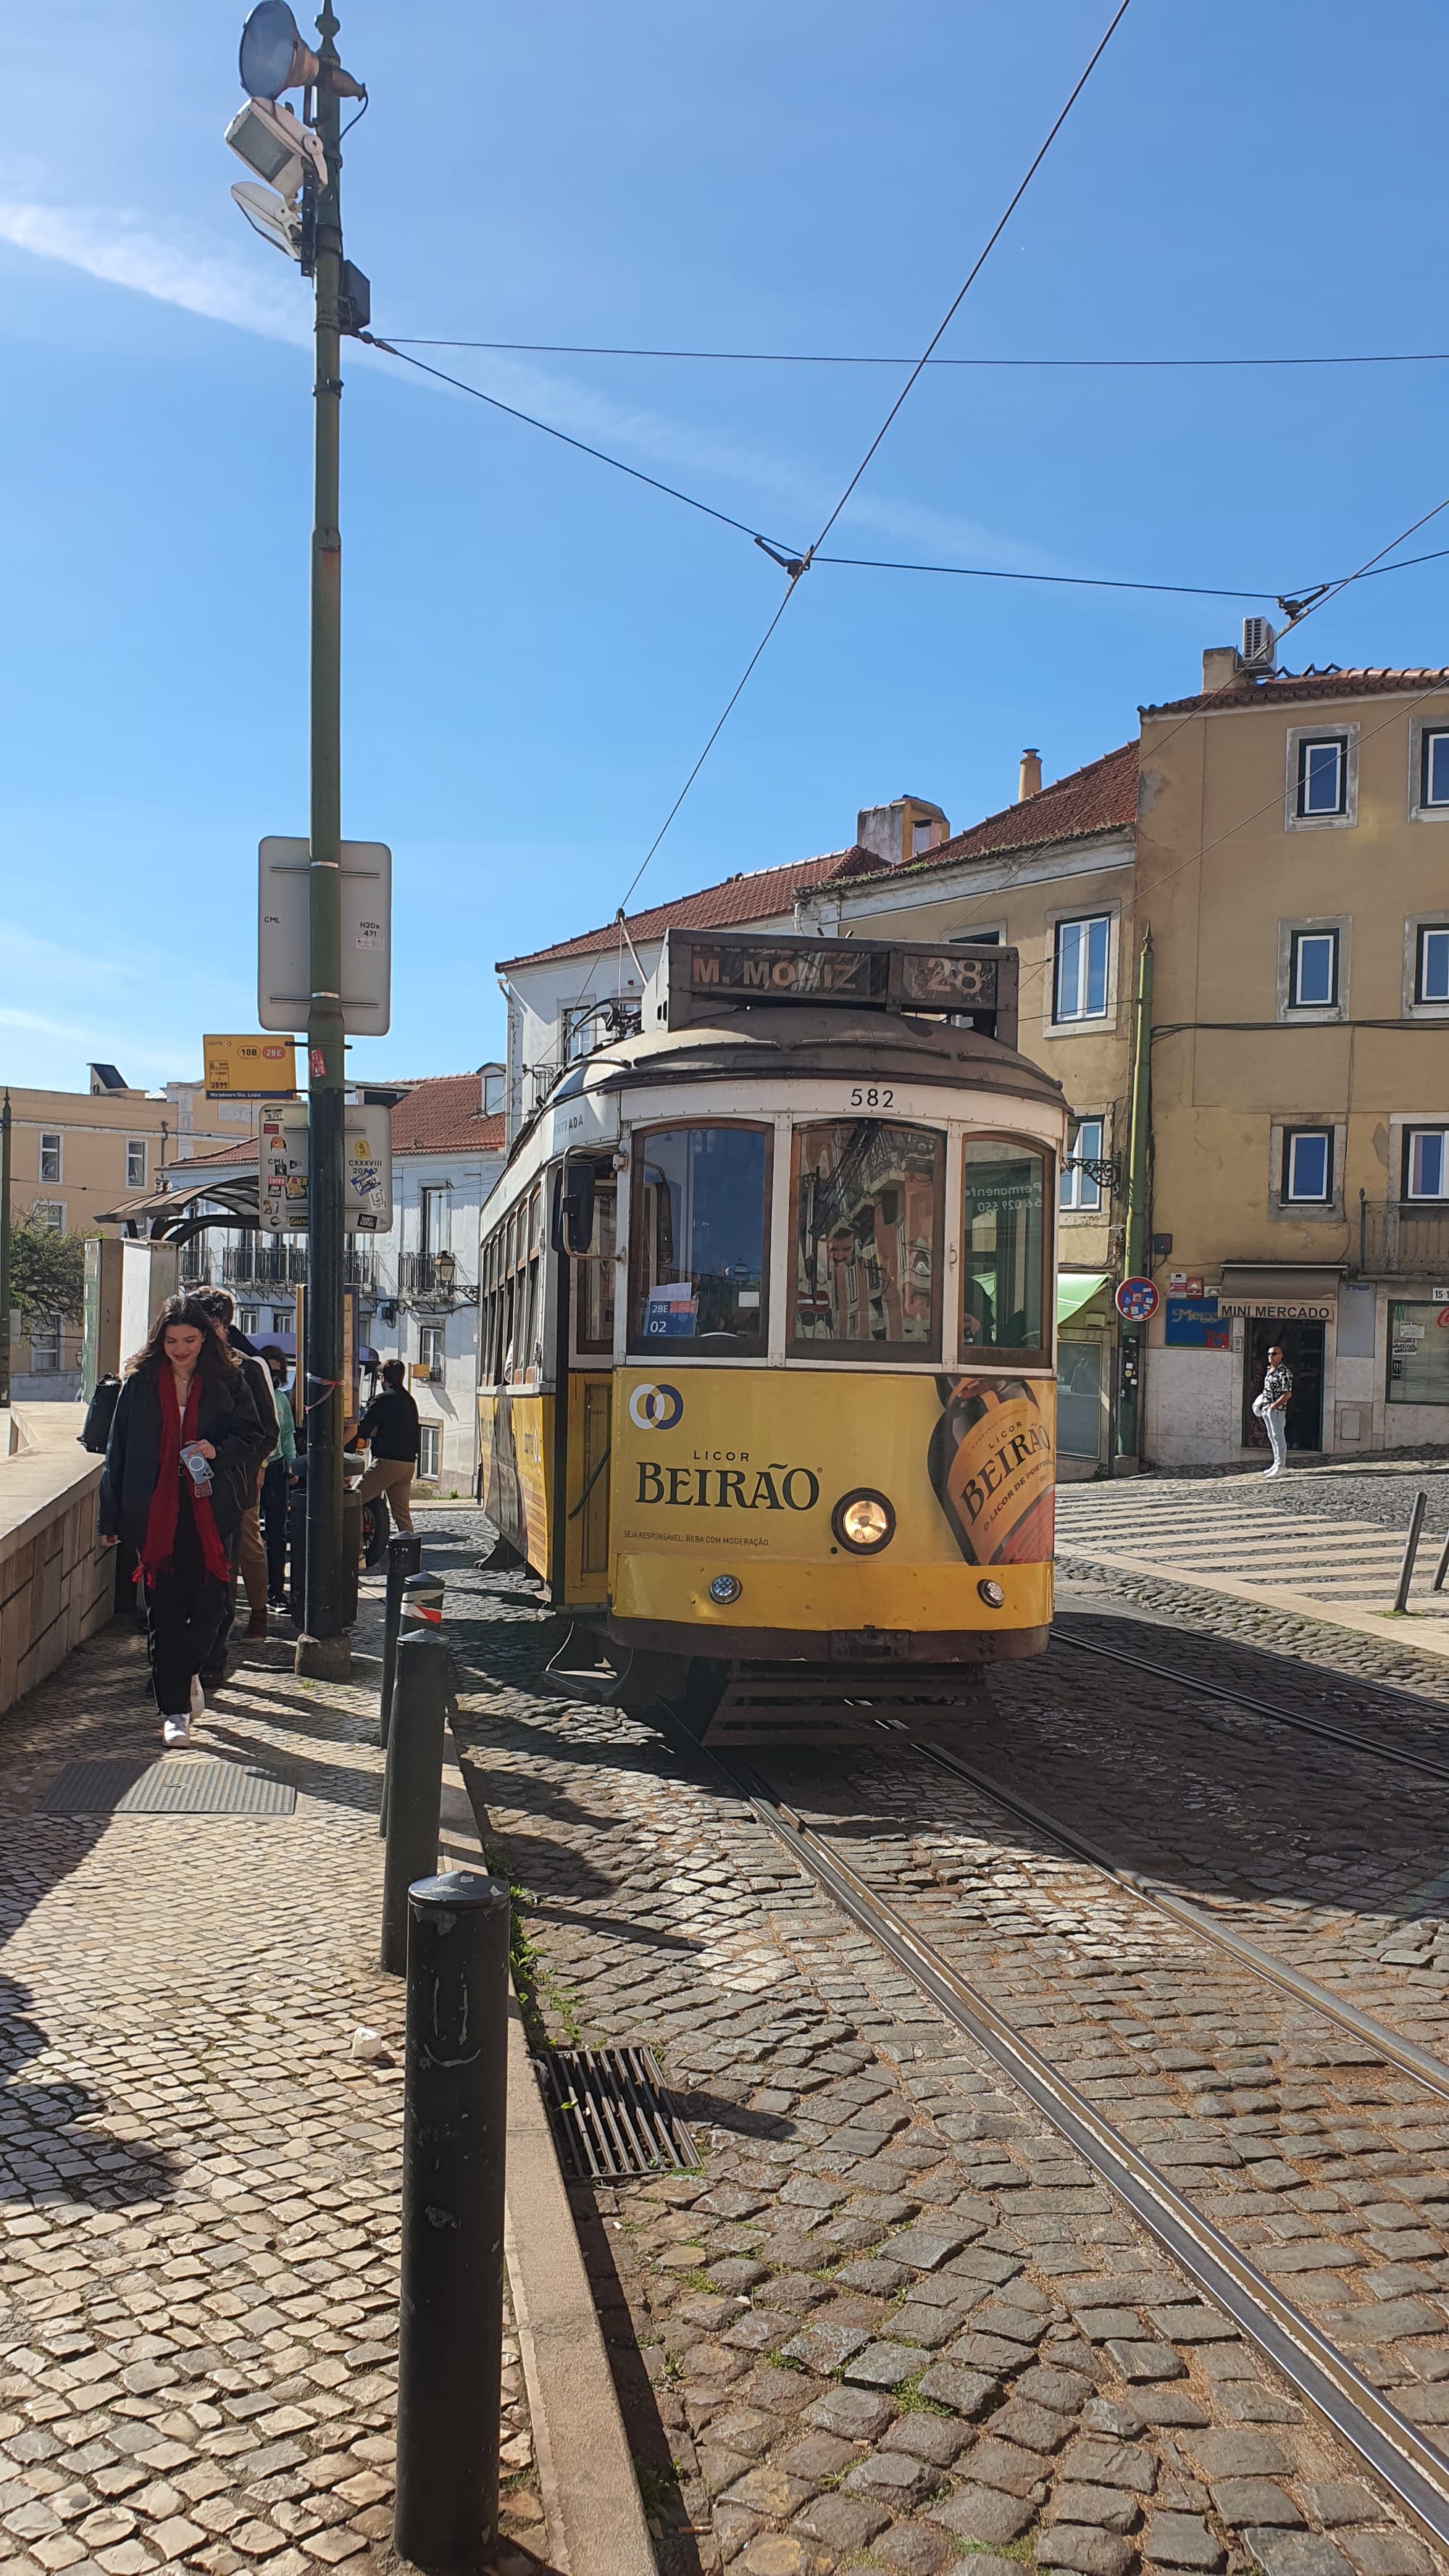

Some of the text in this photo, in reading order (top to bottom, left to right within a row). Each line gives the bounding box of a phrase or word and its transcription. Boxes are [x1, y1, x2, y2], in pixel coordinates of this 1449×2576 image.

[693, 958, 730, 984] M.
[927, 957, 982, 994] 28
[851, 1089, 893, 1108] 582
[652, 1305, 669, 1313] 28E
[1222, 1305, 1329, 1318] MINI MERCADO
[650, 1321, 667, 1333] 02
[987, 1421, 1022, 1450] LICOR
[693, 1450, 749, 1462] LICOR
[961, 1423, 1051, 1525] BEIRÃO
[990, 1490, 1014, 1523] LICOR
[1014, 1477, 1026, 1492] DE
